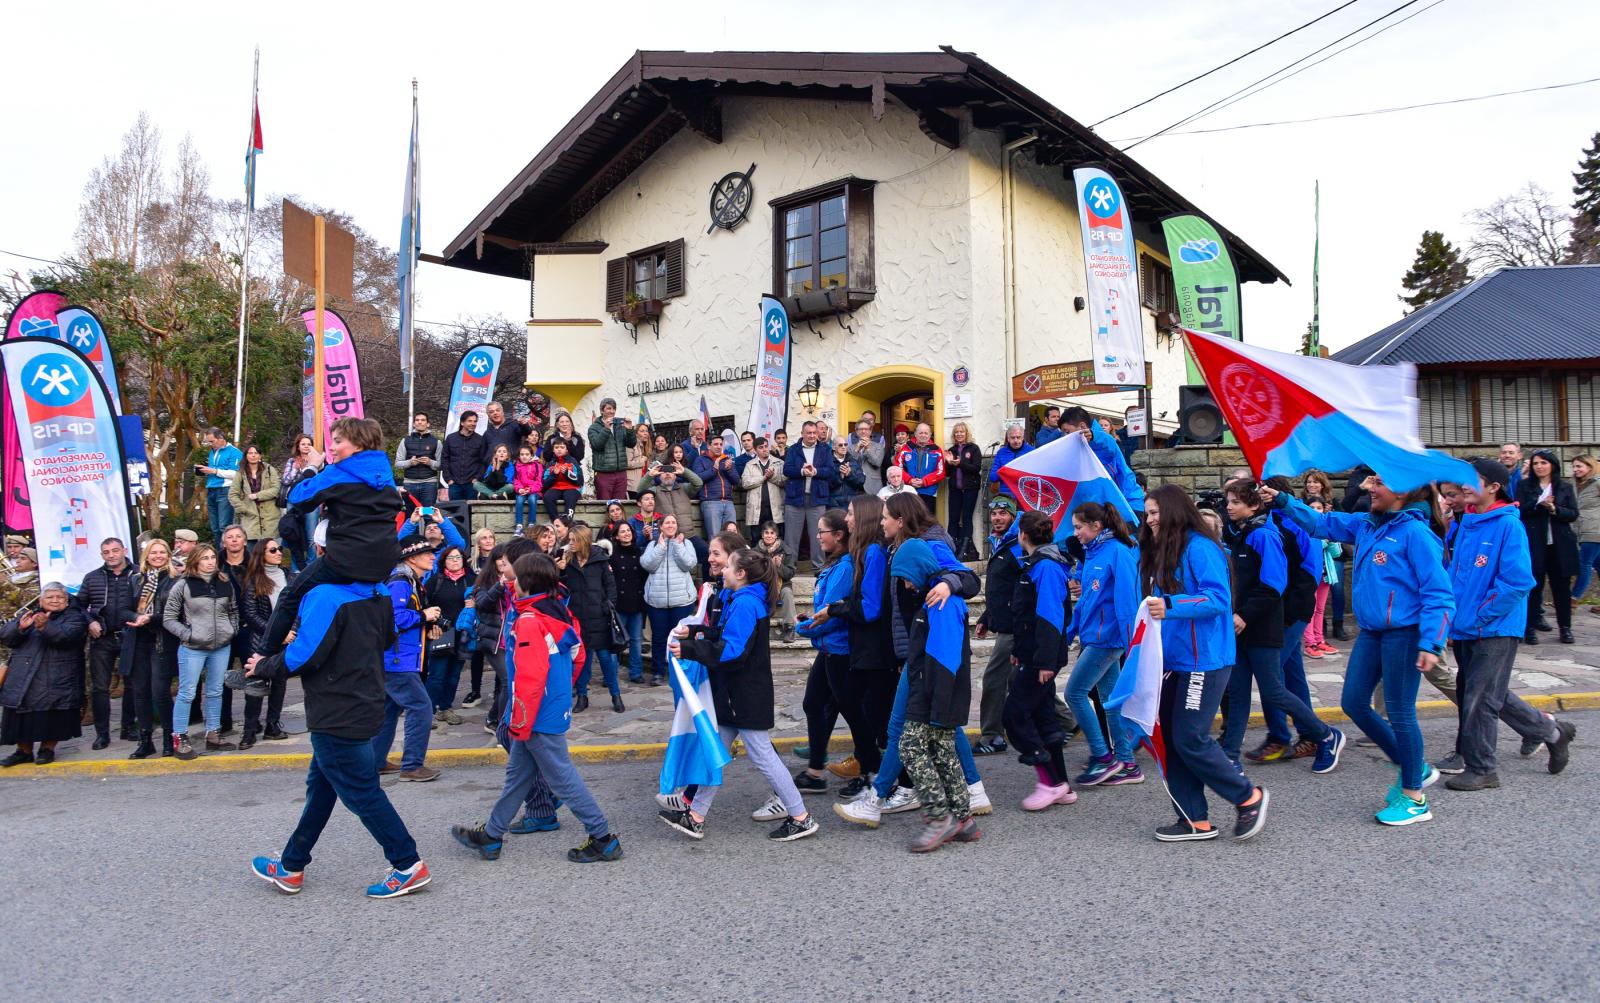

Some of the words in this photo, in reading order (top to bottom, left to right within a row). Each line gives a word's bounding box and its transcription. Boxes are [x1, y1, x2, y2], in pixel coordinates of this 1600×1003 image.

[627, 381, 650, 397] CLUB
[653, 375, 689, 392] ANDINO
[695, 364, 757, 386] BARILOCHE
[1041, 371, 1078, 381] BARILOCHE
[1185, 671, 1205, 711] ERCROMBIE
[267, 863, 277, 875] N
[385, 878, 401, 890] N
